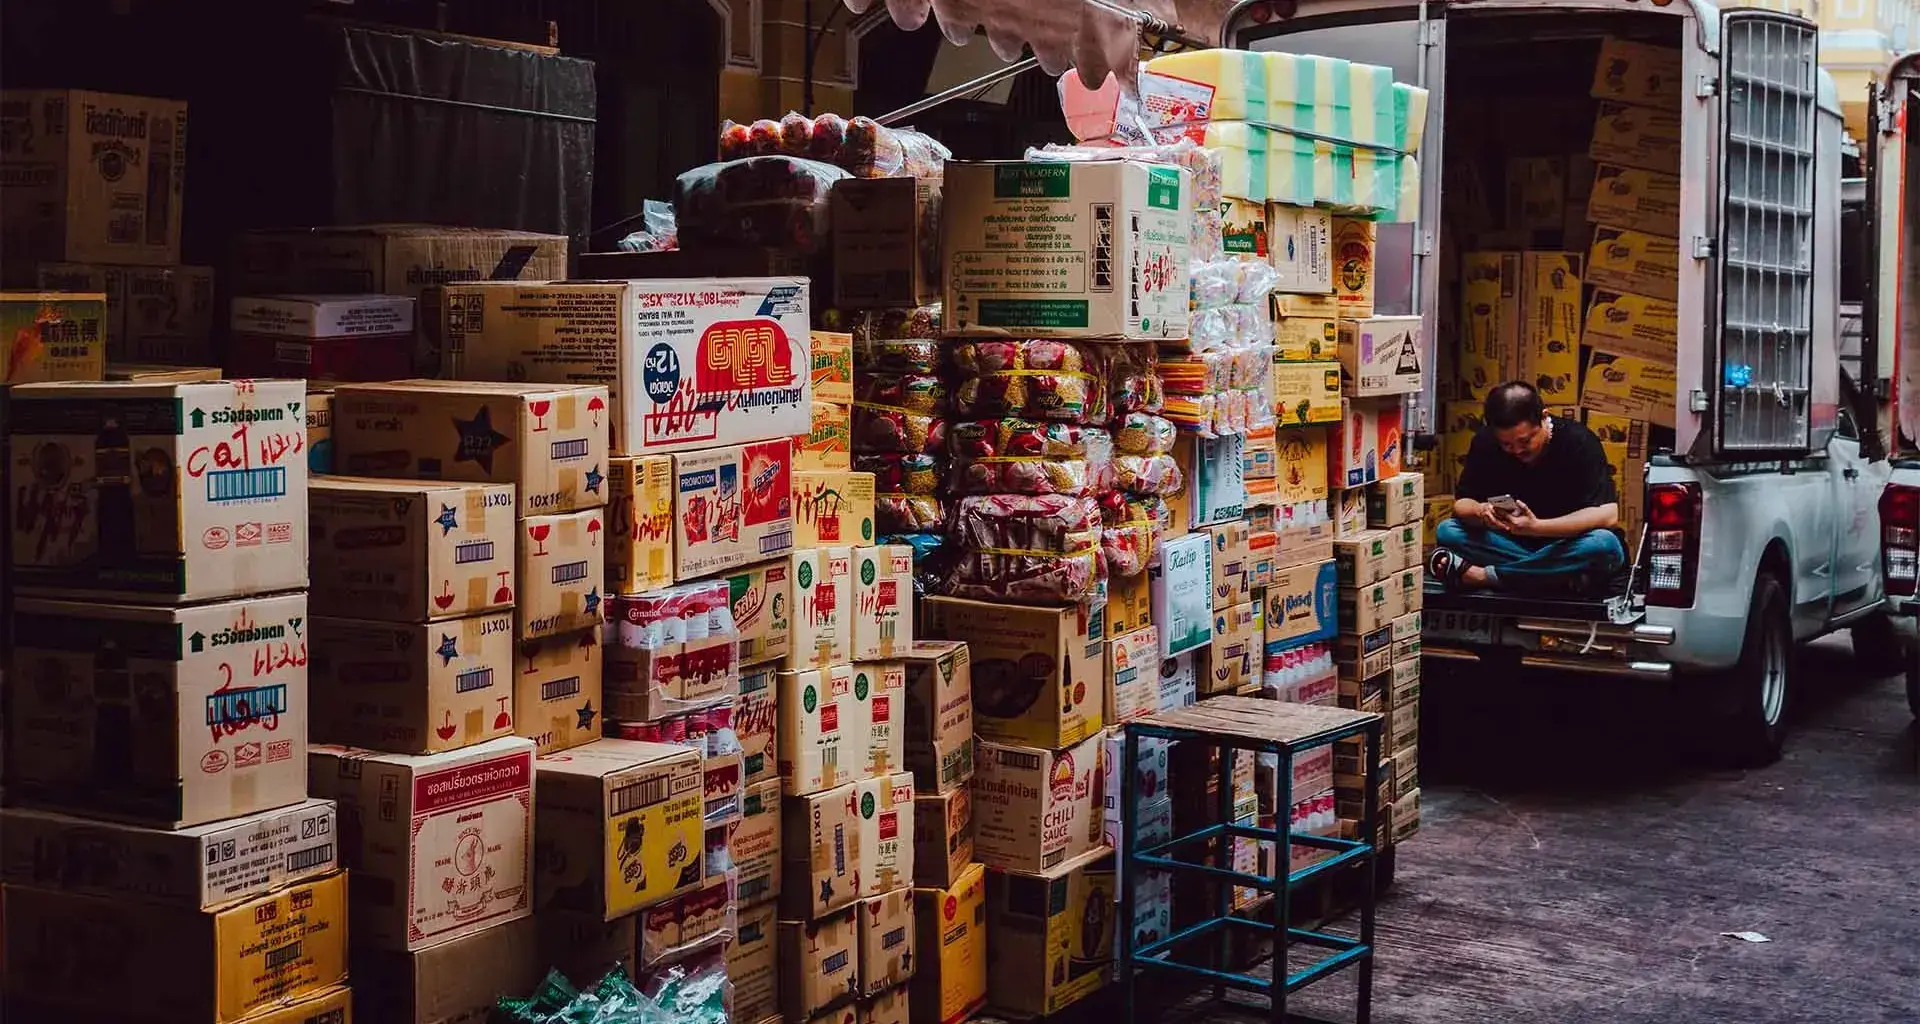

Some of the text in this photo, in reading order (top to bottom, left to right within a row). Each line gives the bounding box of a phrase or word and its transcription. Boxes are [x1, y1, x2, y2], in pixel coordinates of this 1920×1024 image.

[680, 471, 715, 487] PROMOTION
[1043, 806, 1074, 827] CHILI
[1043, 824, 1068, 843] SAUCE
